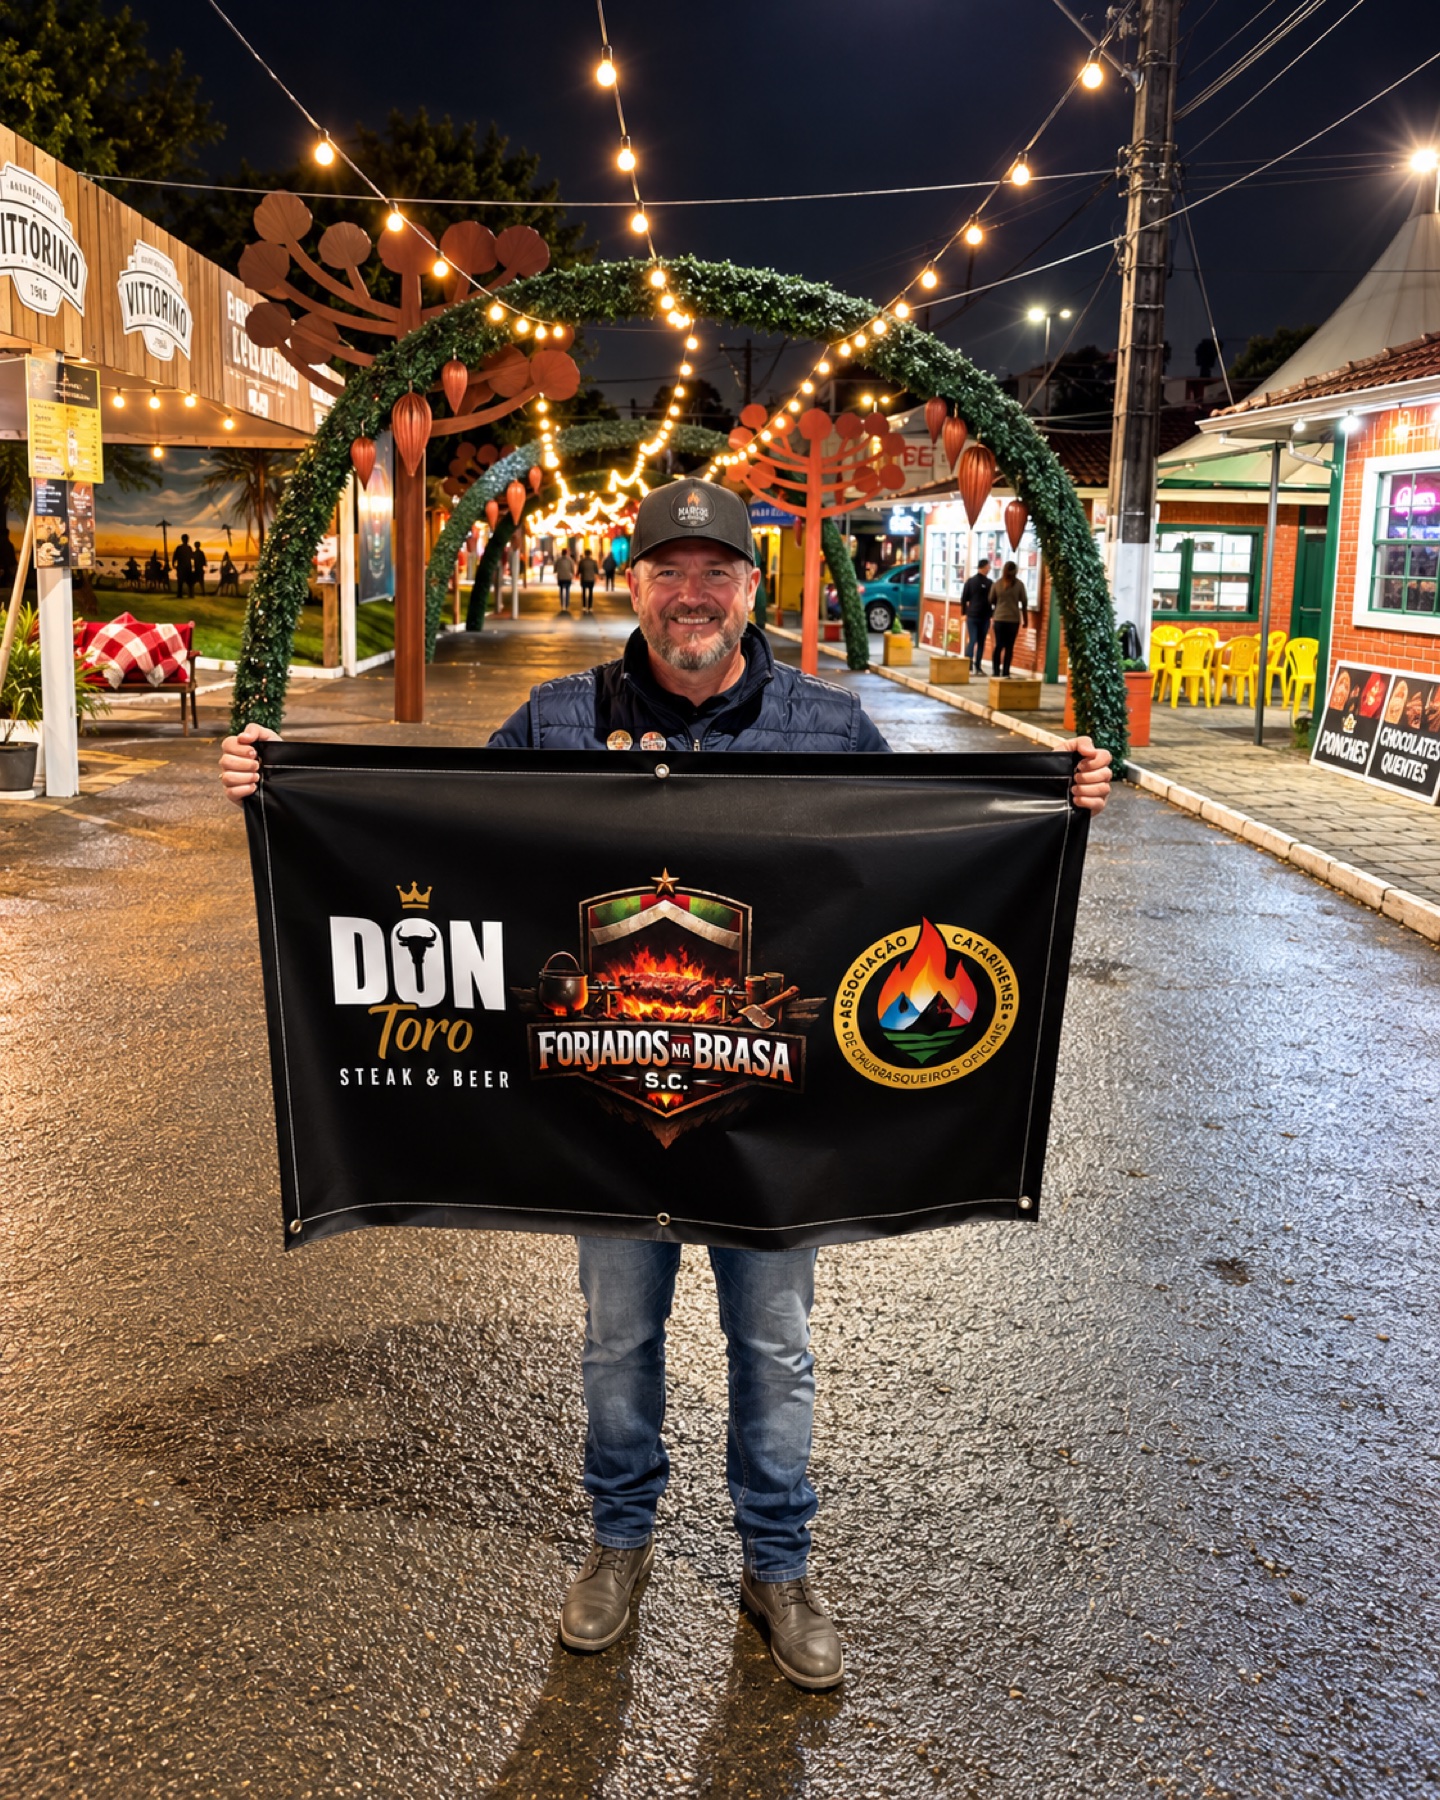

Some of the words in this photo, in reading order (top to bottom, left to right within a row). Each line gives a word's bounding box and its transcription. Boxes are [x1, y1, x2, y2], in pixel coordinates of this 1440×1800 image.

[0, 211, 79, 290] ITTORINO
[1319, 730, 1369, 765] PONCHES
[1380, 726, 1440, 761] CHOCOLATES
[1381, 751, 1429, 783] QUENTES
[329, 915, 506, 1011] DON
[839, 935, 907, 1019] ASSOCIAÇÃO
[952, 933, 1013, 1011] CATARINENSE
[368, 1003, 473, 1060] Toro
[843, 1031, 857, 1049] DE
[962, 1023, 1007, 1068] OFICIAIS
[339, 1067, 413, 1086] STEAK
[426, 1068, 440, 1086] &
[453, 1069, 509, 1089] BEER
[537, 1030, 670, 1073] FORJADOS
[671, 1042, 692, 1060] NA
[692, 1032, 794, 1083] BRASA
[644, 1071, 689, 1091] S.C.
